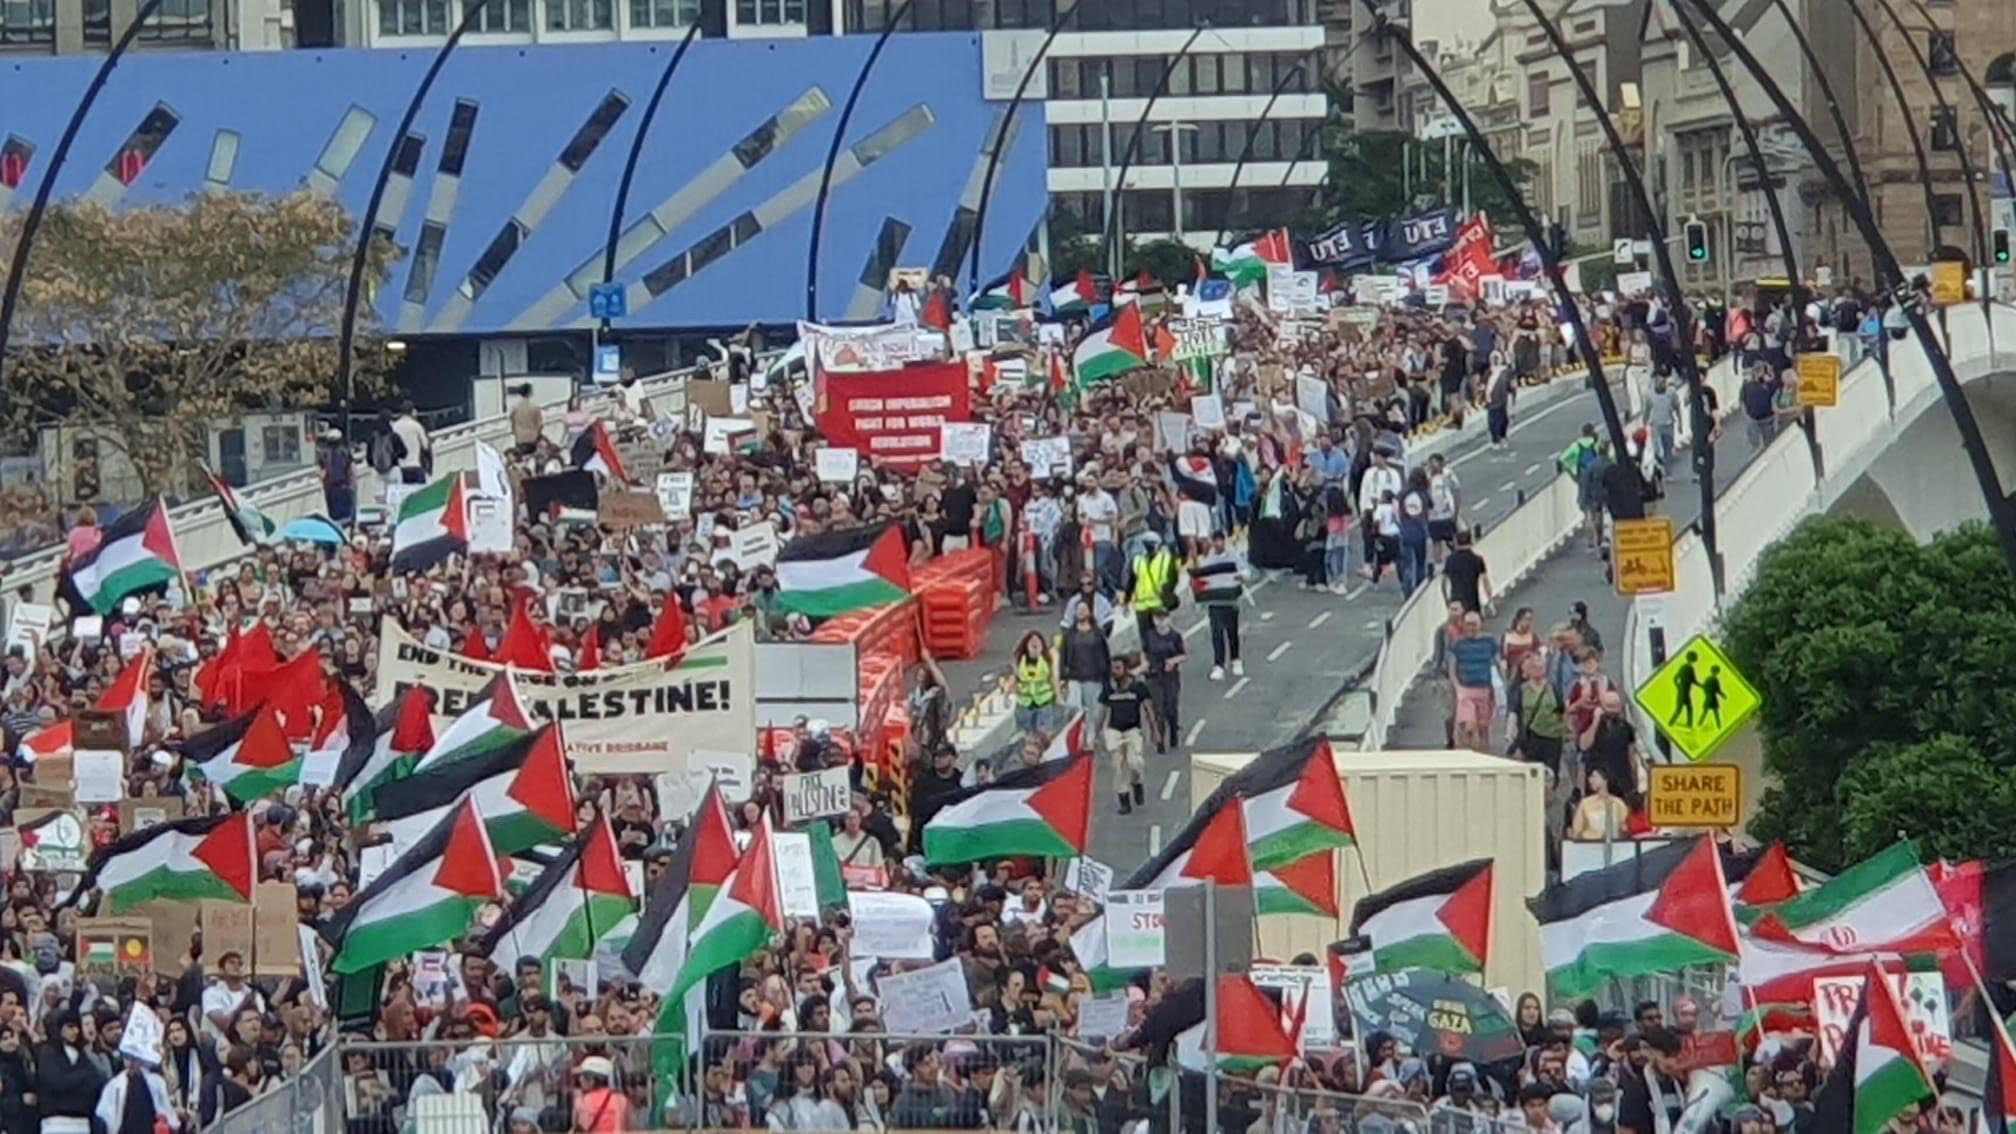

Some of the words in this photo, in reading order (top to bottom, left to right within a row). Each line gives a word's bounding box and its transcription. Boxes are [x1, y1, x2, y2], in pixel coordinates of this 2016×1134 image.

[854, 417, 884, 431] FIGHT
[885, 416, 906, 430] FOR
[397, 642, 440, 665] END
[530, 679, 730, 720] ALESTINE!
[566, 742, 602, 753] ATIVE
[606, 740, 669, 753] BRISBANE
[1662, 775, 1726, 793] SHARE
[1655, 797, 1685, 817] THE
[1691, 796, 1734, 818] PATH
[1427, 1011, 1472, 1035] GAZA
